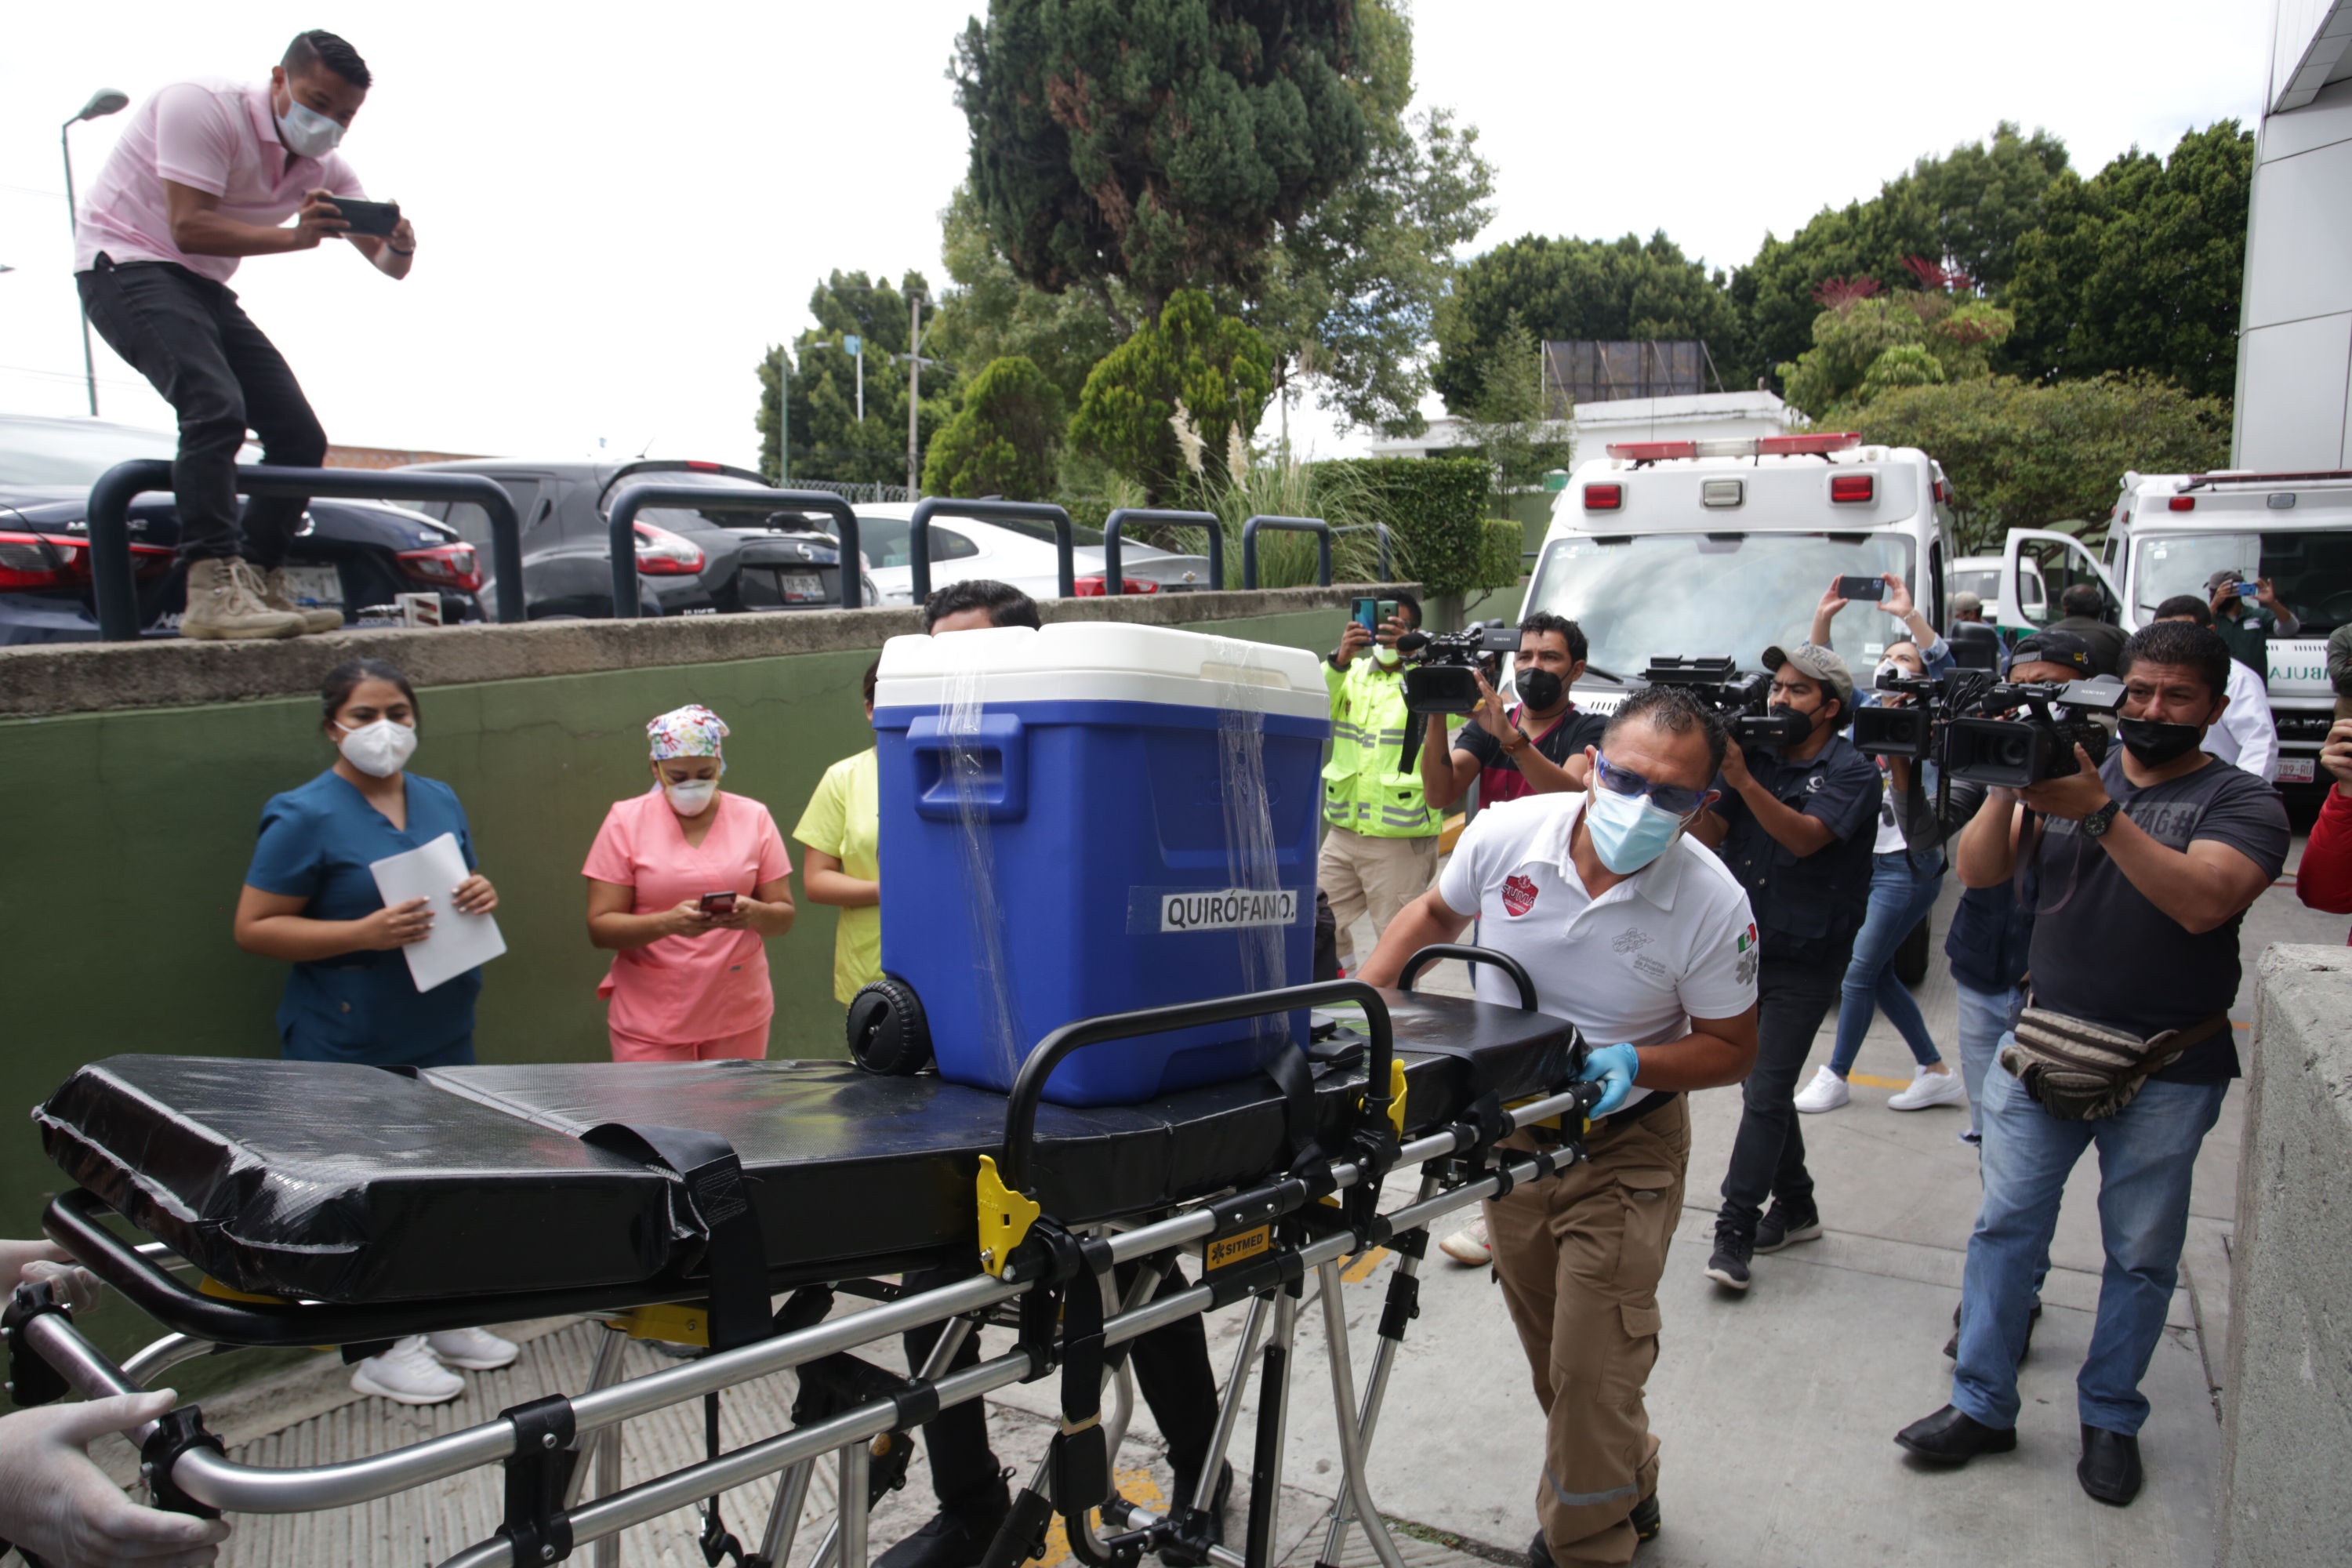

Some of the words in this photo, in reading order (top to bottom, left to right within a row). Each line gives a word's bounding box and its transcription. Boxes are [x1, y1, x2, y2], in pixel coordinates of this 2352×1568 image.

[1501, 884, 1535, 908] SUMA
[1167, 889, 1294, 929] QUIRÓFANO.
[1225, 1233, 1263, 1255] SITMED
